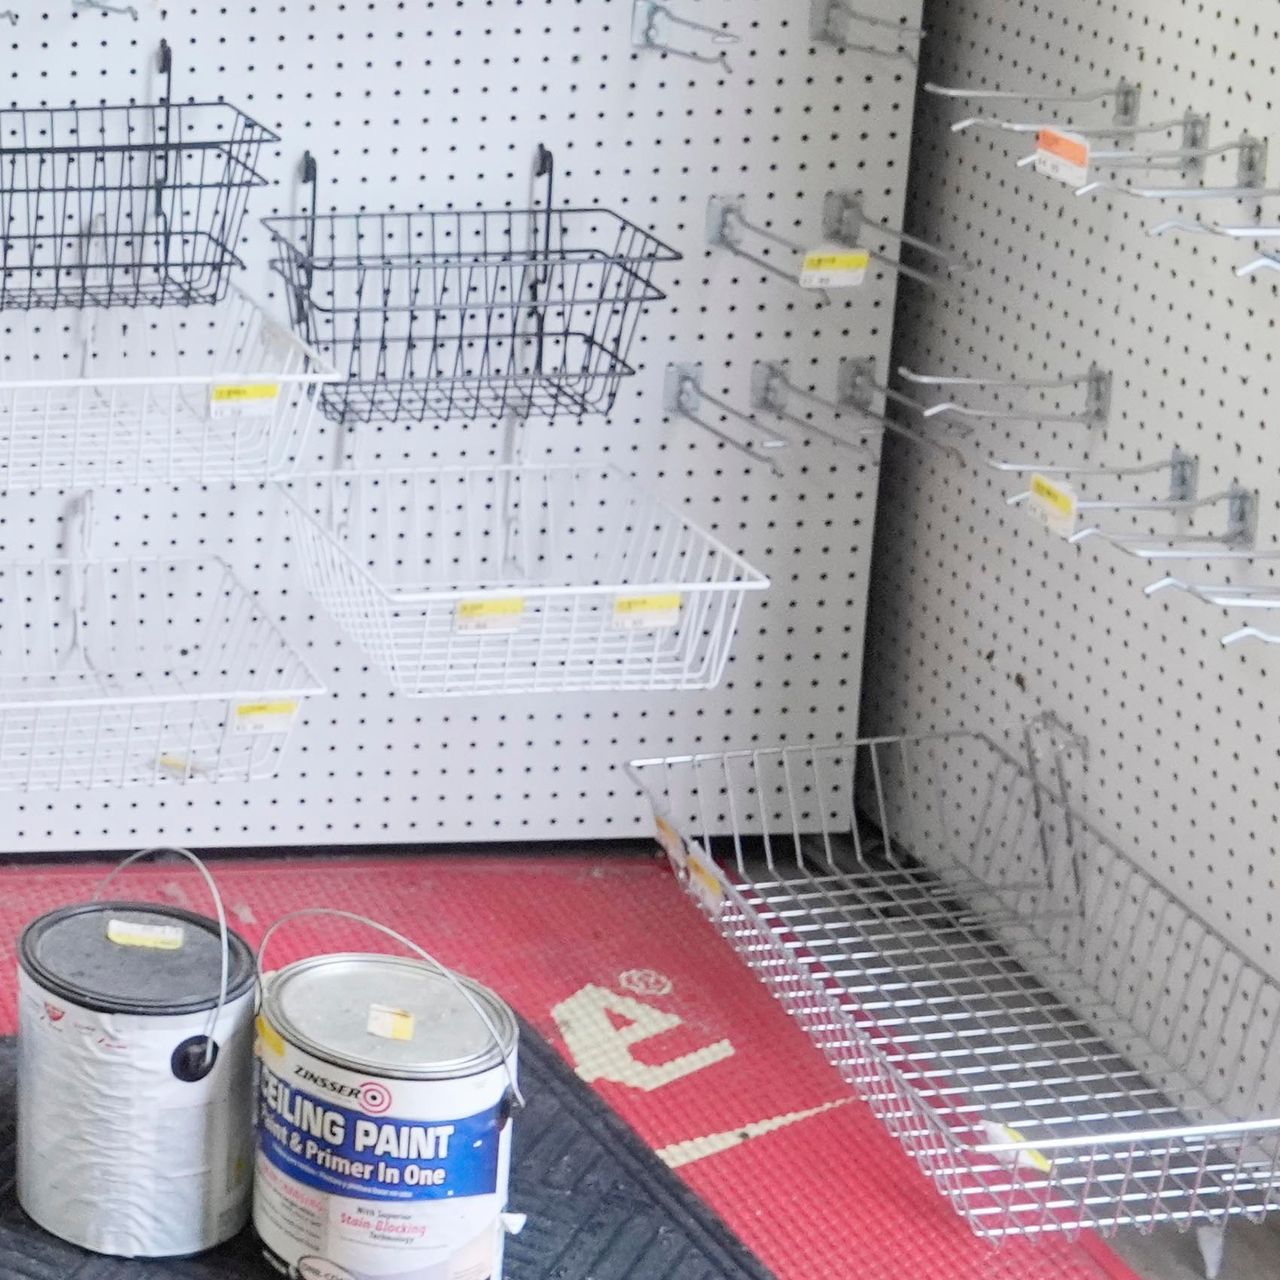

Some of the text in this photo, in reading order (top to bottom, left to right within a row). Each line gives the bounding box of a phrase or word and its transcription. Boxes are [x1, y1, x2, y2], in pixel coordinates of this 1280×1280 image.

[293, 1064, 362, 1099] ZINSSER
[288, 1131, 304, 1154] &
[304, 1136, 373, 1182] Primer
[377, 1161, 400, 1185] In
[403, 1164, 447, 1187] One
[354, 1116, 455, 1161] PAINT
